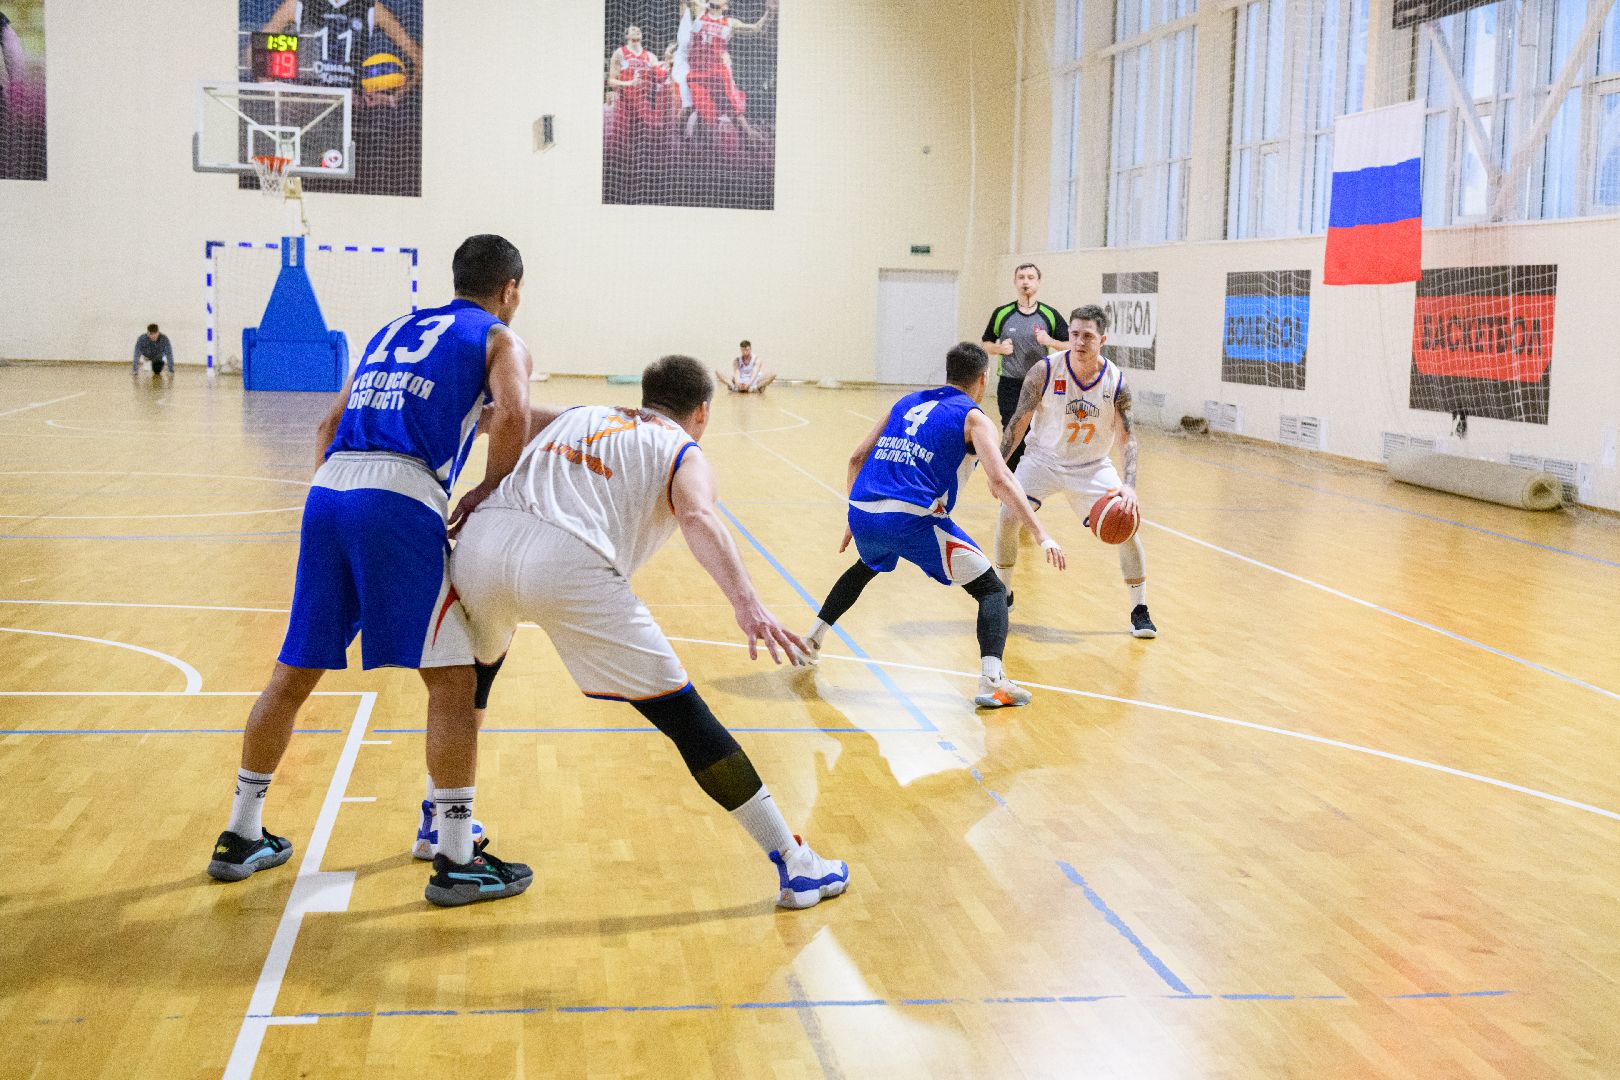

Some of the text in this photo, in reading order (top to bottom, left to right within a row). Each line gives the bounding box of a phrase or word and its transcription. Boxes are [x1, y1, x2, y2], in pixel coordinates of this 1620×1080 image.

[267, 34, 298, 51] 1:54
[314, 26, 353, 63] 11
[274, 52, 296, 78] 19
[1105, 300, 1151, 335] ФУТБОЛ
[1227, 309, 1303, 348] ВОЛЕЙБОЛ
[1421, 314, 1543, 356] БАСКЕТБОЛ
[365, 314, 455, 366] 13
[902, 400, 940, 436] 4
[1067, 422, 1096, 444] 77
